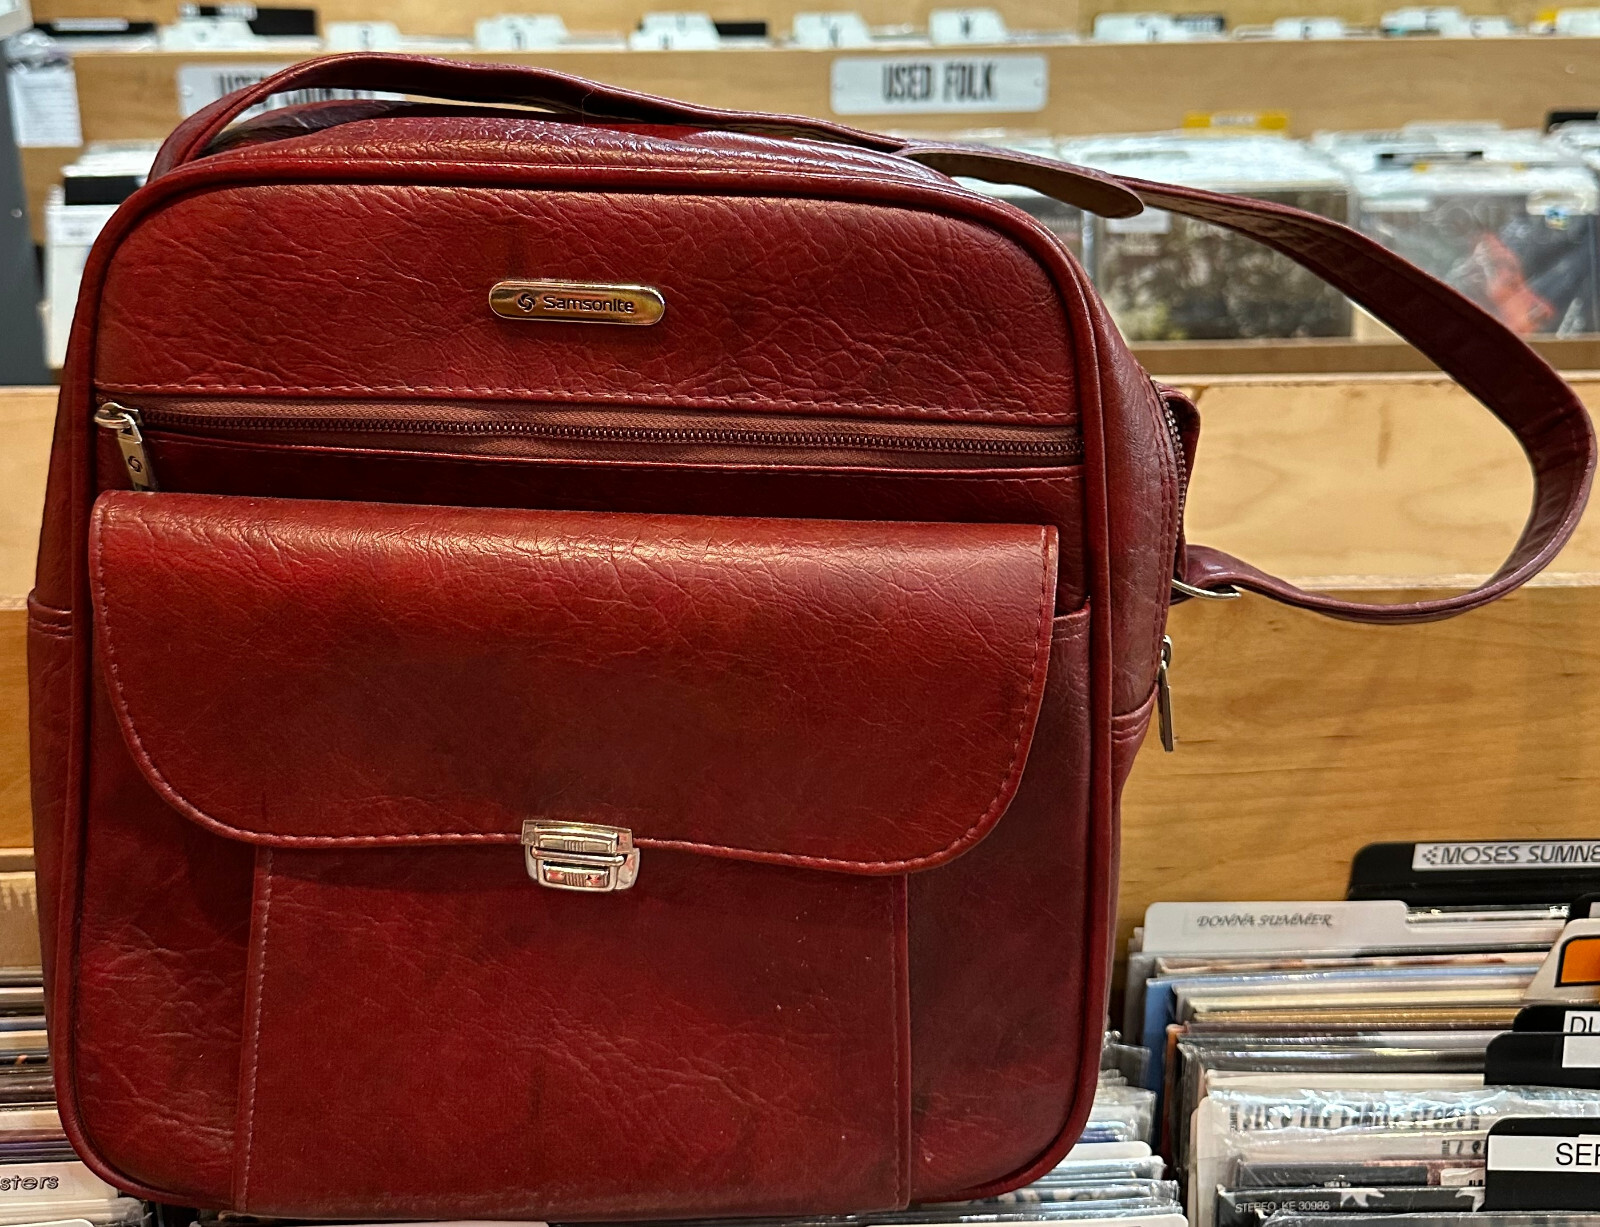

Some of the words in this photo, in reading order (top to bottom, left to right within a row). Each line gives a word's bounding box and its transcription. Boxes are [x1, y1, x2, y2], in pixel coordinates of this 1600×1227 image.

[882, 64, 934, 102] USED
[943, 63, 998, 102] FOLK
[543, 295, 634, 313] Samsonite
[1441, 846, 1519, 864] MOSES
[1197, 913, 1254, 927] DONNA
[1257, 912, 1333, 928] SUMMER
[1298, 1200, 1331, 1211] 30986
